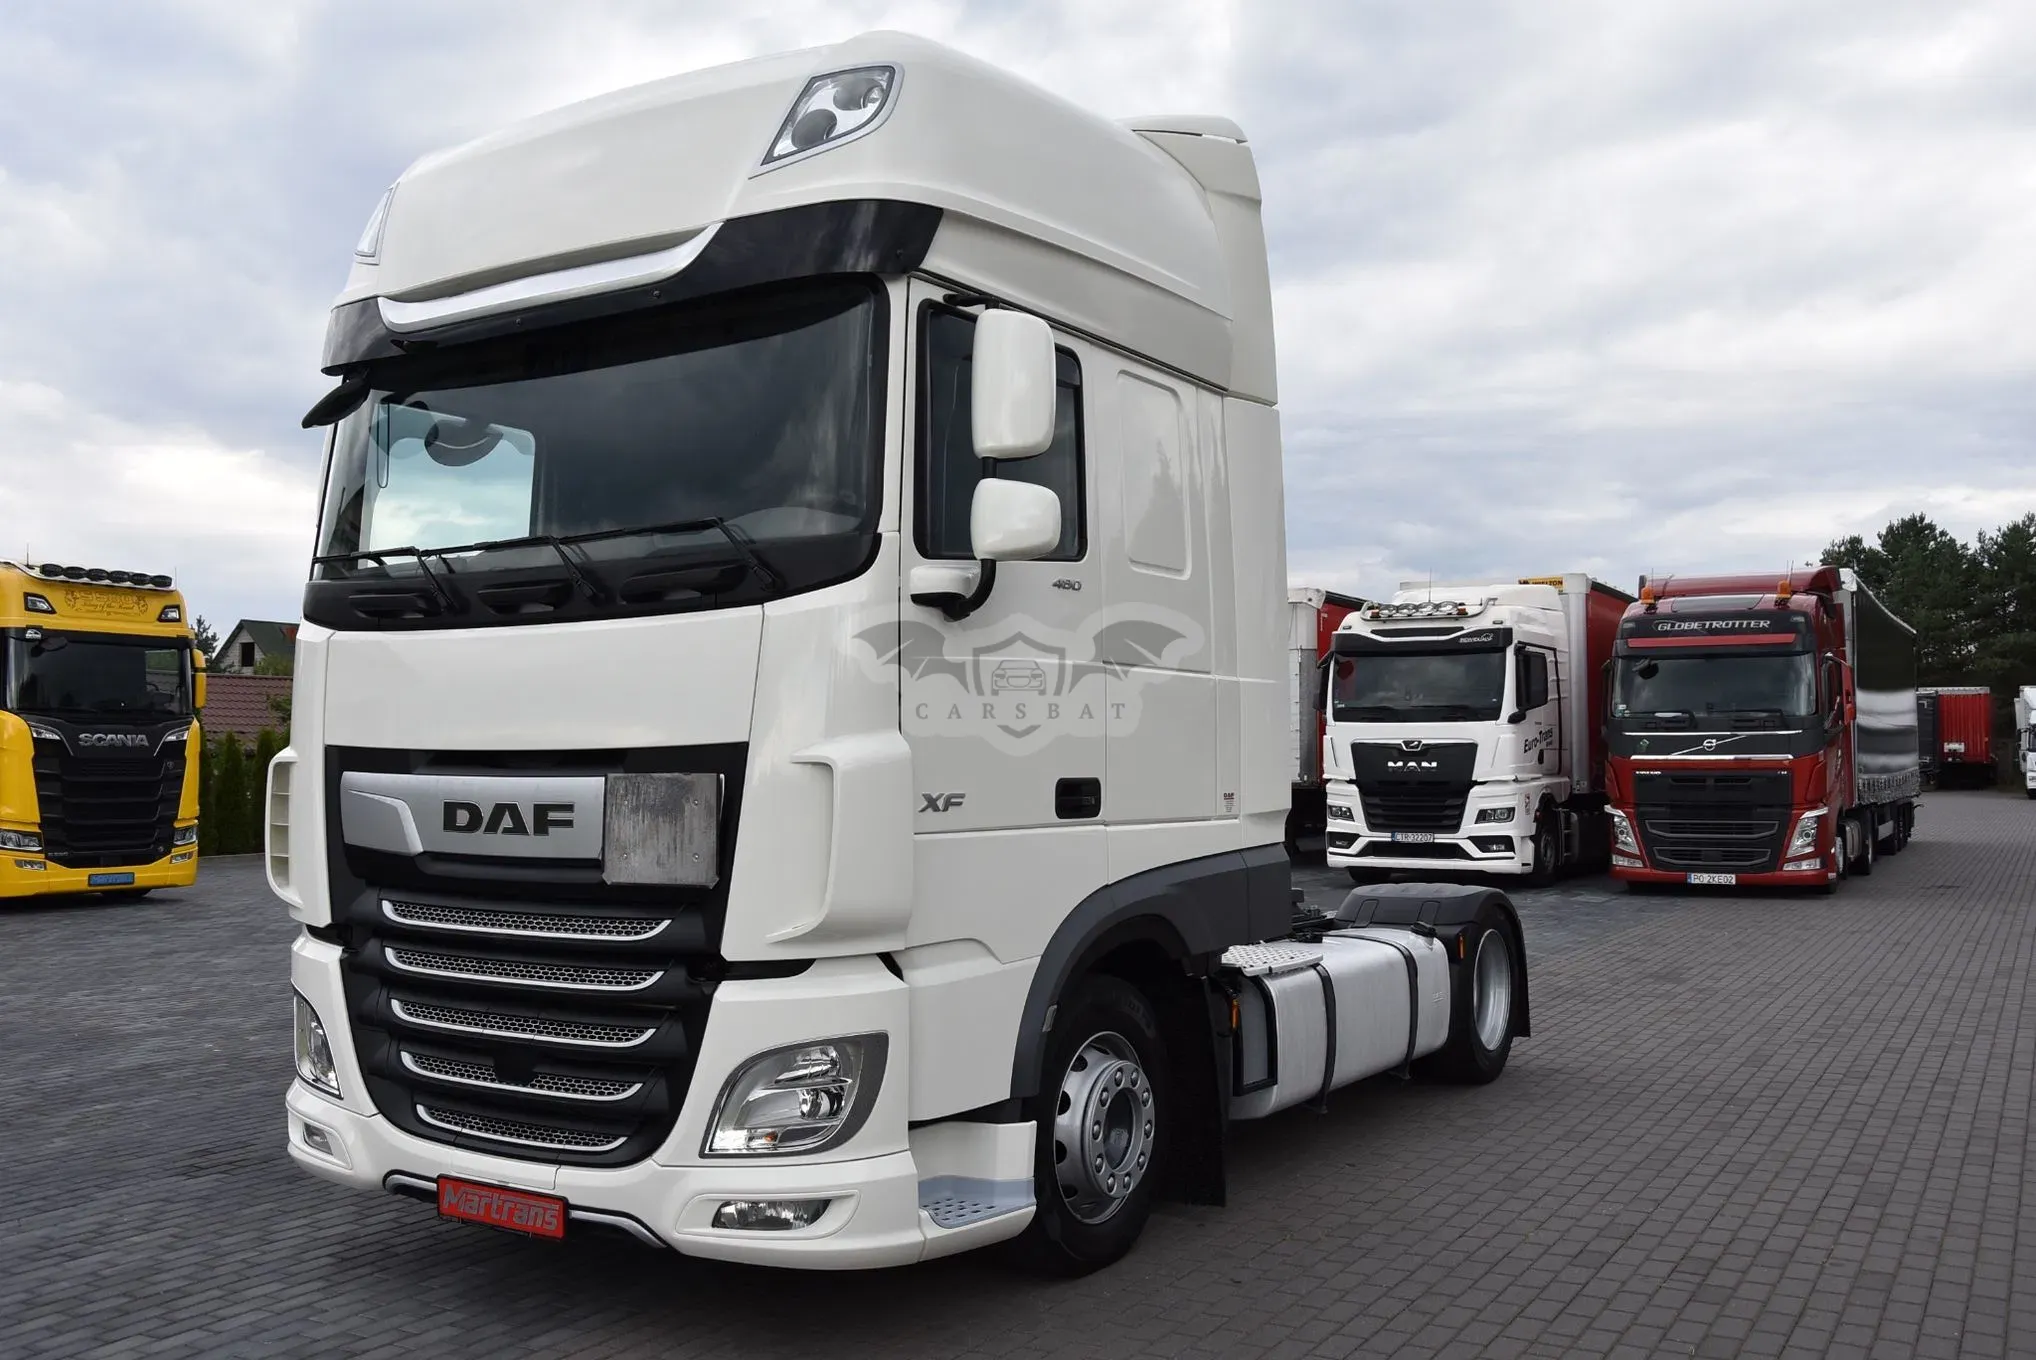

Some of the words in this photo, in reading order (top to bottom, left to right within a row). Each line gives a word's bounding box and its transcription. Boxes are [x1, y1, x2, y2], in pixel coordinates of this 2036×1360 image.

[1052, 579, 1082, 591] 460
[1657, 620, 1771, 631] GLOBETROTTER
[78, 733, 149, 747] SCANIA
[1387, 761, 1438, 771] MAN
[918, 792, 966, 813] XF
[442, 800, 575, 836] DAF
[1693, 874, 1705, 883] PO
[443, 1183, 560, 1231] Martrans
